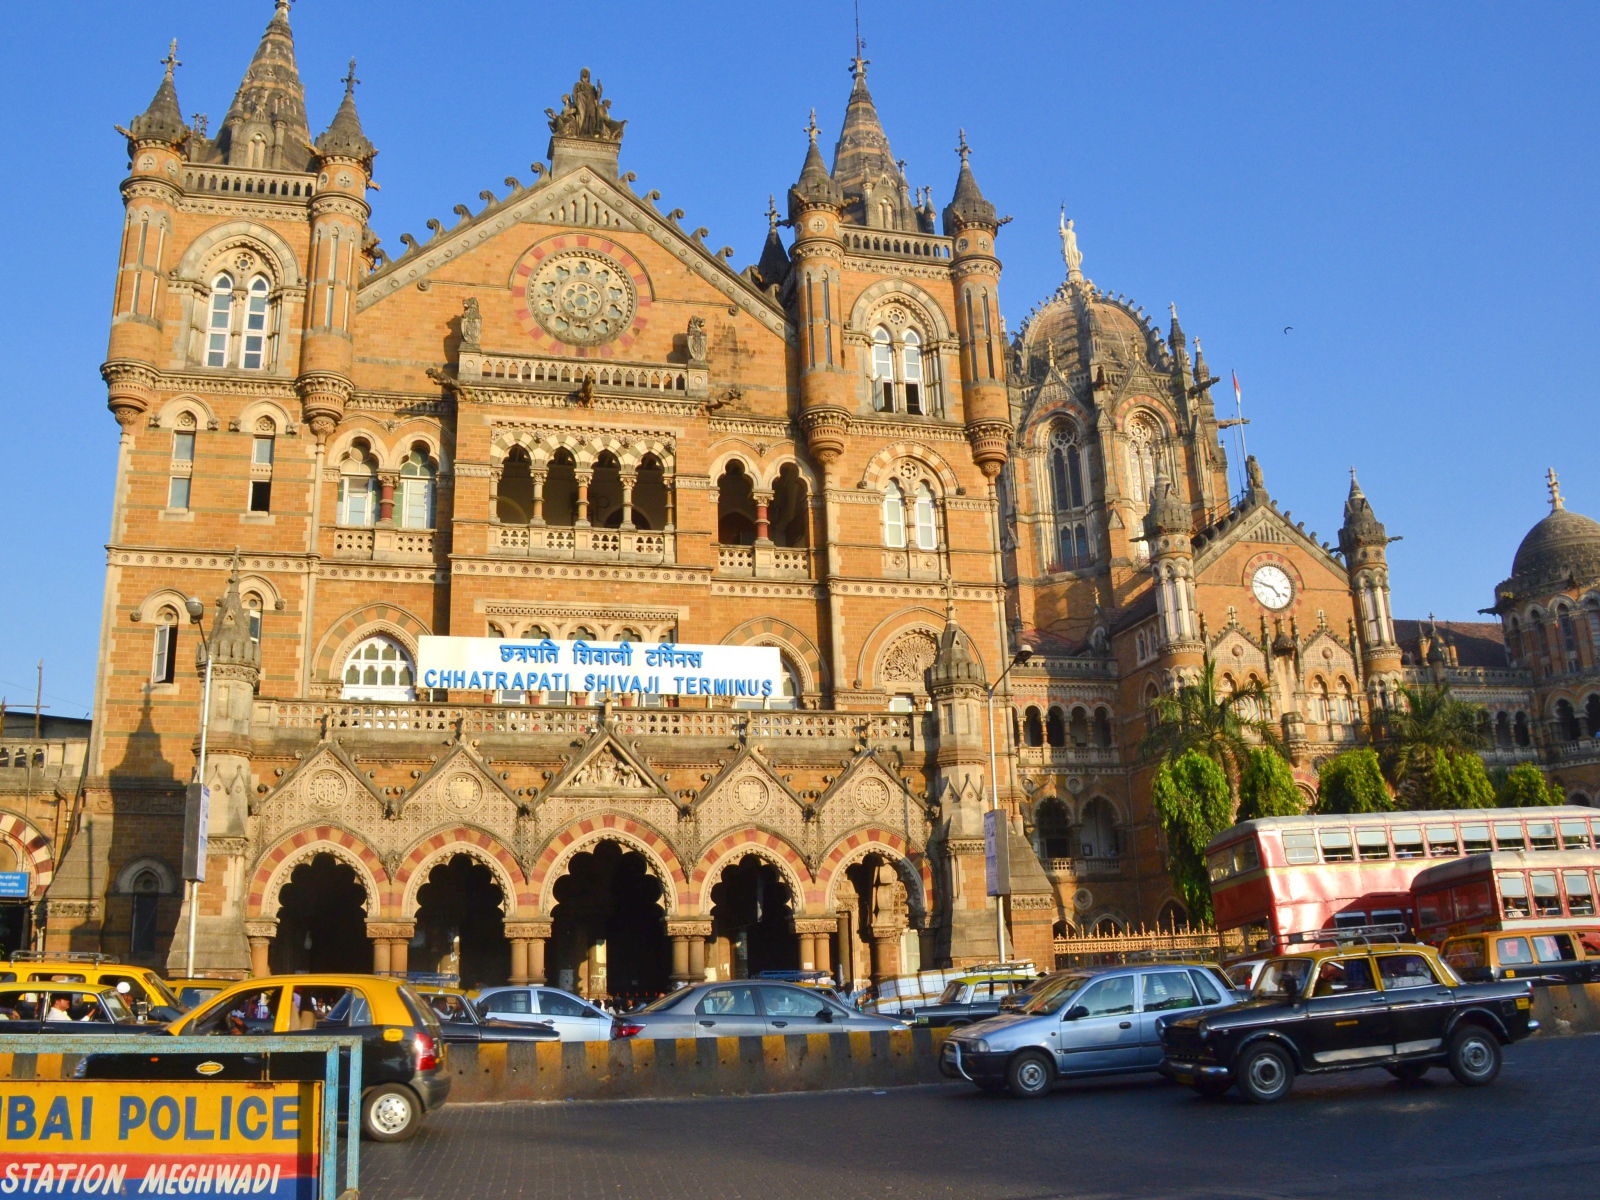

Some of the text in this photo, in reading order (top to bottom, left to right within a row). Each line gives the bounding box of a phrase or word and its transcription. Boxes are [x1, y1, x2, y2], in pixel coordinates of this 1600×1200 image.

[500, 638, 703, 668] छत्रपति शिवाजी टर्मिनस
[425, 669, 773, 697] CHHATRAPATI SHIVAJI TERMINUS
[0, 1095, 302, 1140] BAI POLICE
[1, 1163, 281, 1195] STATION MEGHWADI
